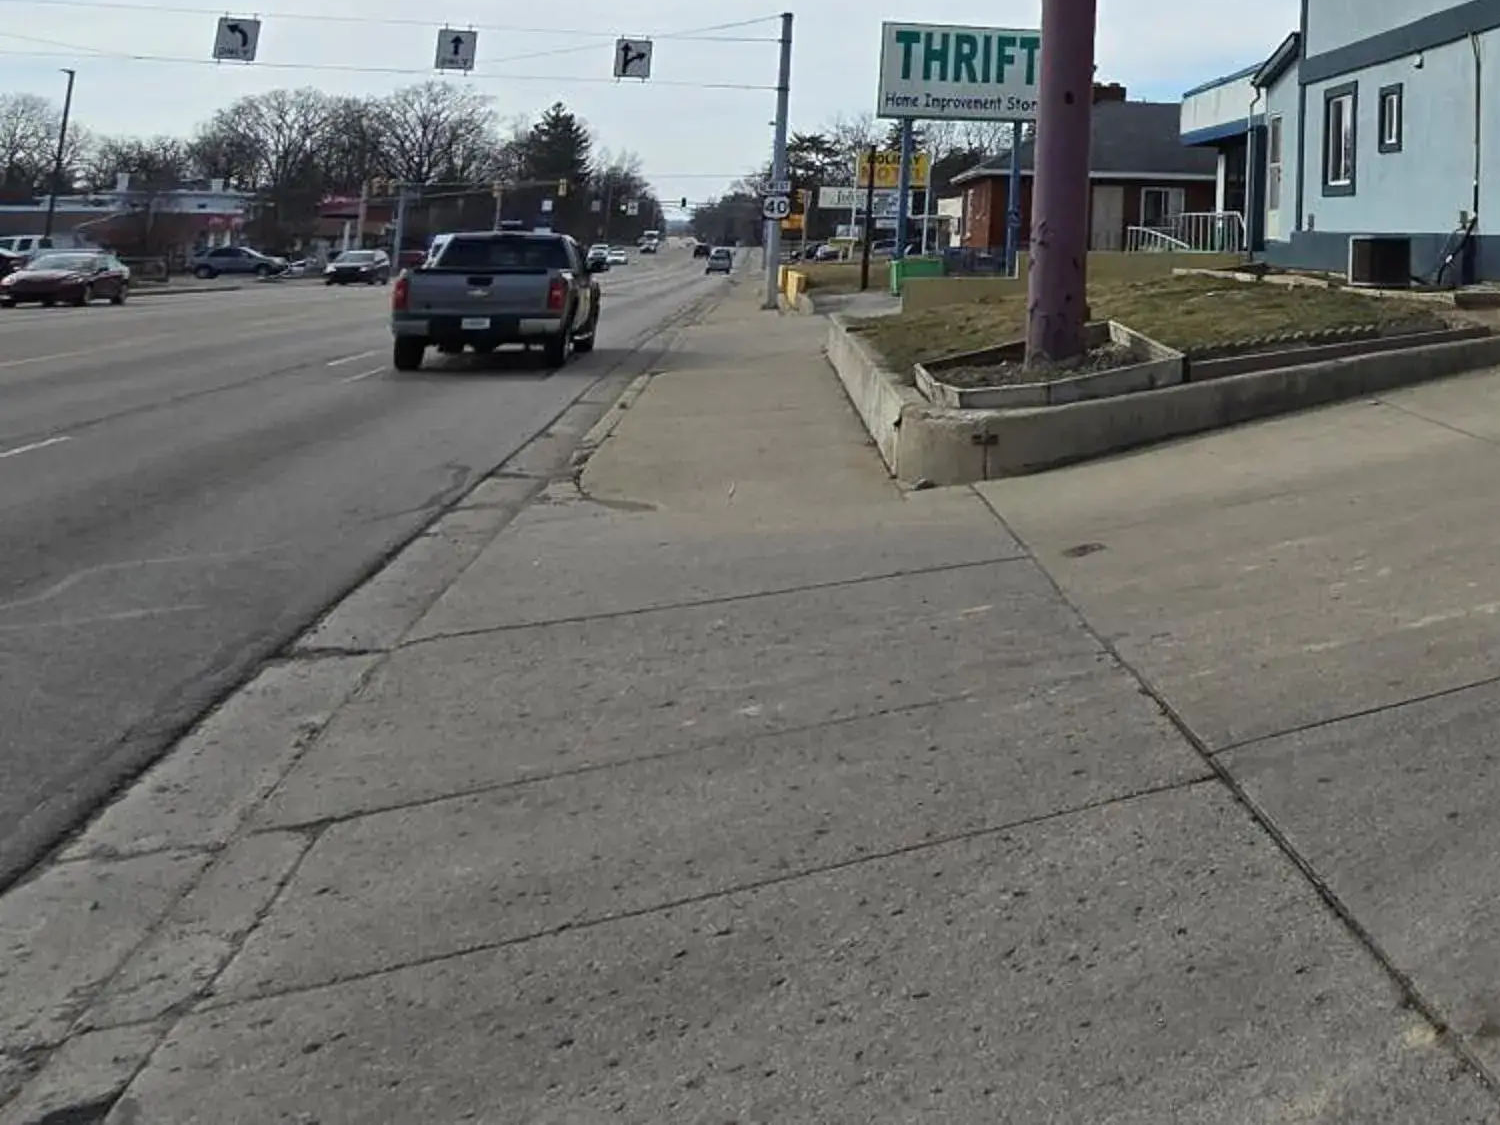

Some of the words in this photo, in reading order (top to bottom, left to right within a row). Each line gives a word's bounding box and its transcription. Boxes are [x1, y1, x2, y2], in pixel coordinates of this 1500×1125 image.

[896, 30, 1040, 86] THRIFT
[885, 91, 919, 108] Home
[924, 93, 1003, 113] Improvement
[1007, 96, 1039, 112] Stor
[766, 200, 787, 214] 40
